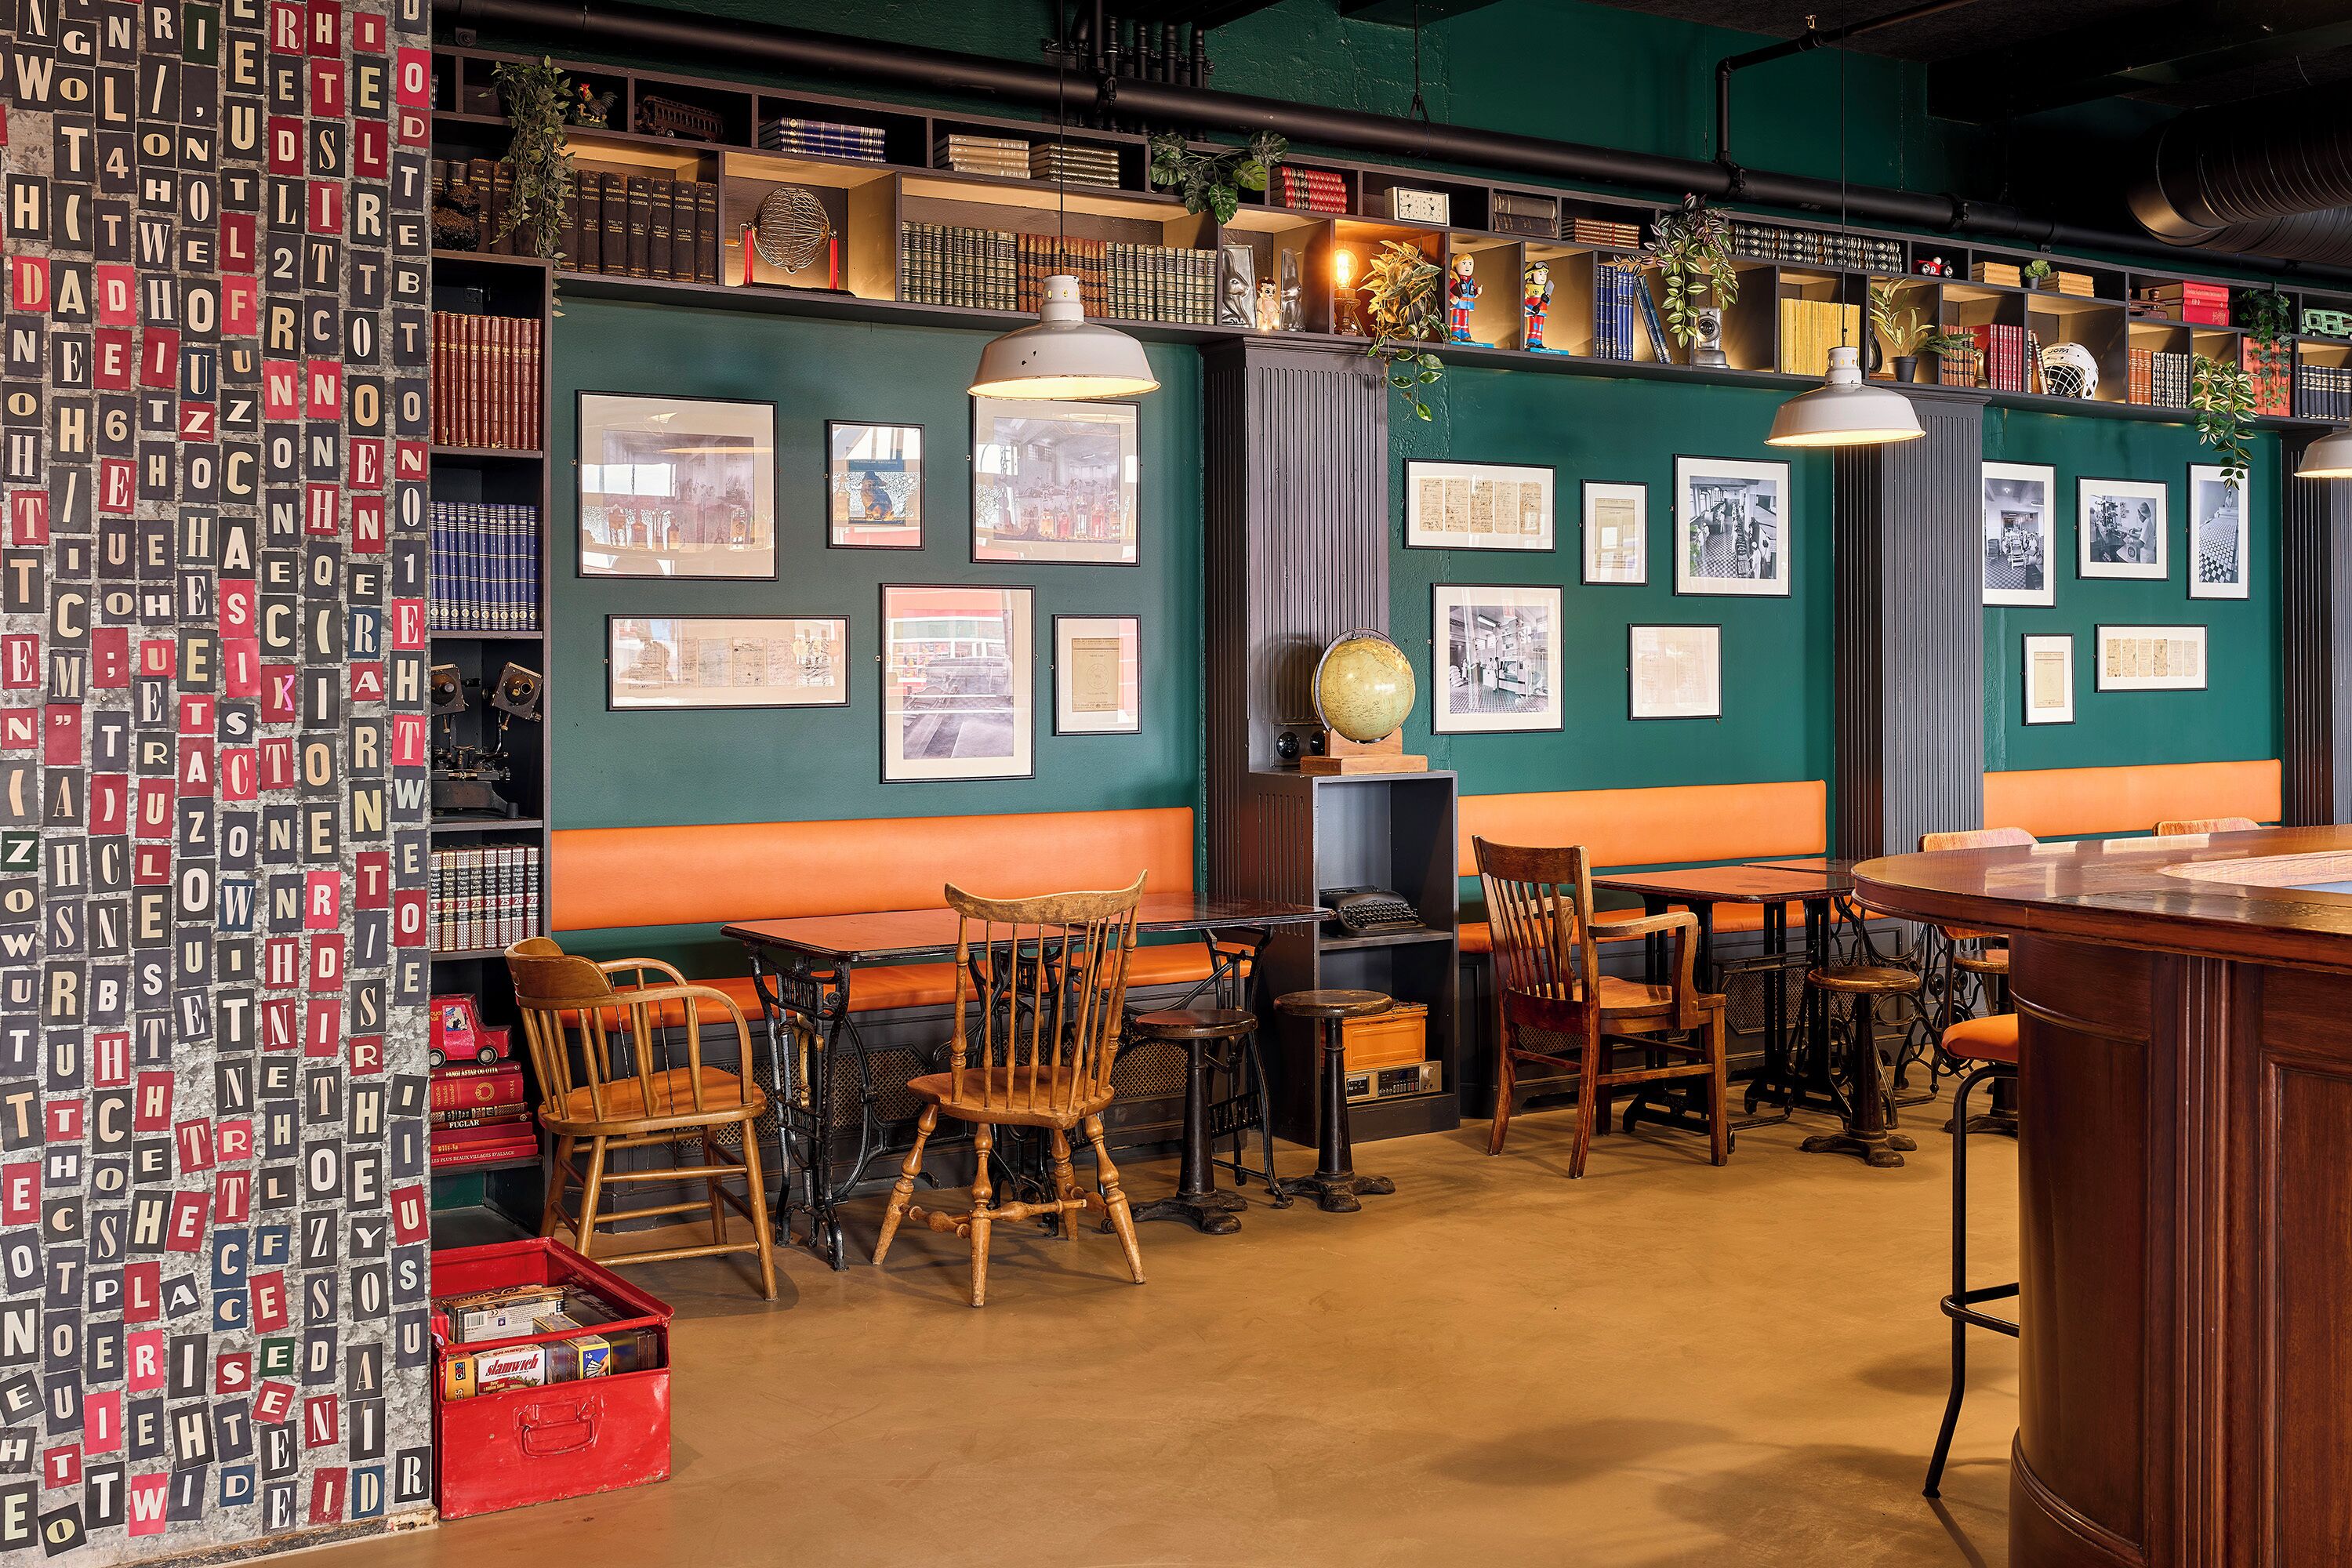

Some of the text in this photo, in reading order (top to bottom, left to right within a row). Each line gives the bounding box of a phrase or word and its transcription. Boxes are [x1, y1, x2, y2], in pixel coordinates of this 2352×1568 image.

[64, 31, 90, 55] G
[235, 41, 256, 85] E
[105, 77, 126, 122] L
[278, 70, 294, 100] E
[361, 67, 380, 109] E
[404, 116, 424, 137] D
[61, 126, 88, 172] T
[143, 134, 170, 156] O
[278, 130, 294, 161] D
[401, 166, 418, 196] T
[15, 184, 38, 230] H
[277, 184, 296, 224] L
[140, 222, 170, 263] W
[399, 225, 418, 245] E
[274, 248, 292, 278] 2
[21, 263, 42, 304] D
[147, 280, 173, 320] H
[232, 290, 246, 320] F
[13, 330, 35, 362] N
[353, 318, 370, 357] O
[189, 354, 209, 394] U
[270, 376, 292, 405] N
[149, 400, 169, 422] T
[404, 392, 420, 421] O
[60, 408, 84, 452] H
[274, 438, 291, 468] O
[107, 466, 129, 506] E
[227, 452, 253, 494] C
[19, 498, 42, 538] T
[310, 489, 334, 528] H
[359, 510, 378, 539] N
[148, 535, 165, 565] E
[270, 562, 290, 582] E
[57, 593, 84, 637] C
[145, 595, 170, 616] H
[267, 604, 290, 647] C
[10, 641, 32, 681] E
[187, 639, 209, 681] E
[355, 672, 380, 692] A
[397, 660, 418, 701] H
[9, 717, 31, 740] N
[227, 713, 246, 735] S
[144, 742, 167, 764] R
[187, 752, 206, 782] A
[147, 793, 165, 824] U
[354, 790, 382, 832] N
[6, 840, 34, 862] Z
[229, 826, 248, 857] O
[142, 855, 162, 876] L
[364, 866, 381, 895] T
[141, 895, 162, 938] E
[277, 888, 296, 919] N
[56, 906, 74, 948] S
[1, 933, 35, 956] W
[319, 948, 336, 978] D
[405, 963, 419, 992] E
[143, 964, 162, 995] S
[223, 999, 248, 1041] T
[9, 1030, 29, 1062] T
[143, 1018, 165, 1058] T
[268, 1067, 289, 1087] E
[6, 1092, 34, 1138] T
[145, 1086, 164, 1116] H
[449, 1120, 480, 1129] FUGLAR
[223, 1131, 246, 1152] R
[51, 1156, 77, 1178] H
[311, 1149, 336, 1191] O
[13, 1178, 30, 1210] E
[98, 1216, 117, 1258] S
[178, 1206, 198, 1237] E
[355, 1227, 383, 1247] Y
[11, 1246, 33, 1277] O
[221, 1244, 239, 1275] C
[135, 1277, 150, 1308] L
[313, 1279, 328, 1319] S
[220, 1299, 241, 1321] C
[5, 1309, 34, 1356] N
[97, 1336, 113, 1369] E
[311, 1341, 328, 1371] D
[485, 1353, 539, 1377] slamwich
[6, 1384, 32, 1411] E
[261, 1391, 285, 1414] E
[138, 1413, 154, 1446] E
[312, 1401, 331, 1442] N
[52, 1454, 72, 1478] T
[401, 1457, 423, 1495] R
[132, 1487, 166, 1521] W
[270, 1487, 290, 1529] E
